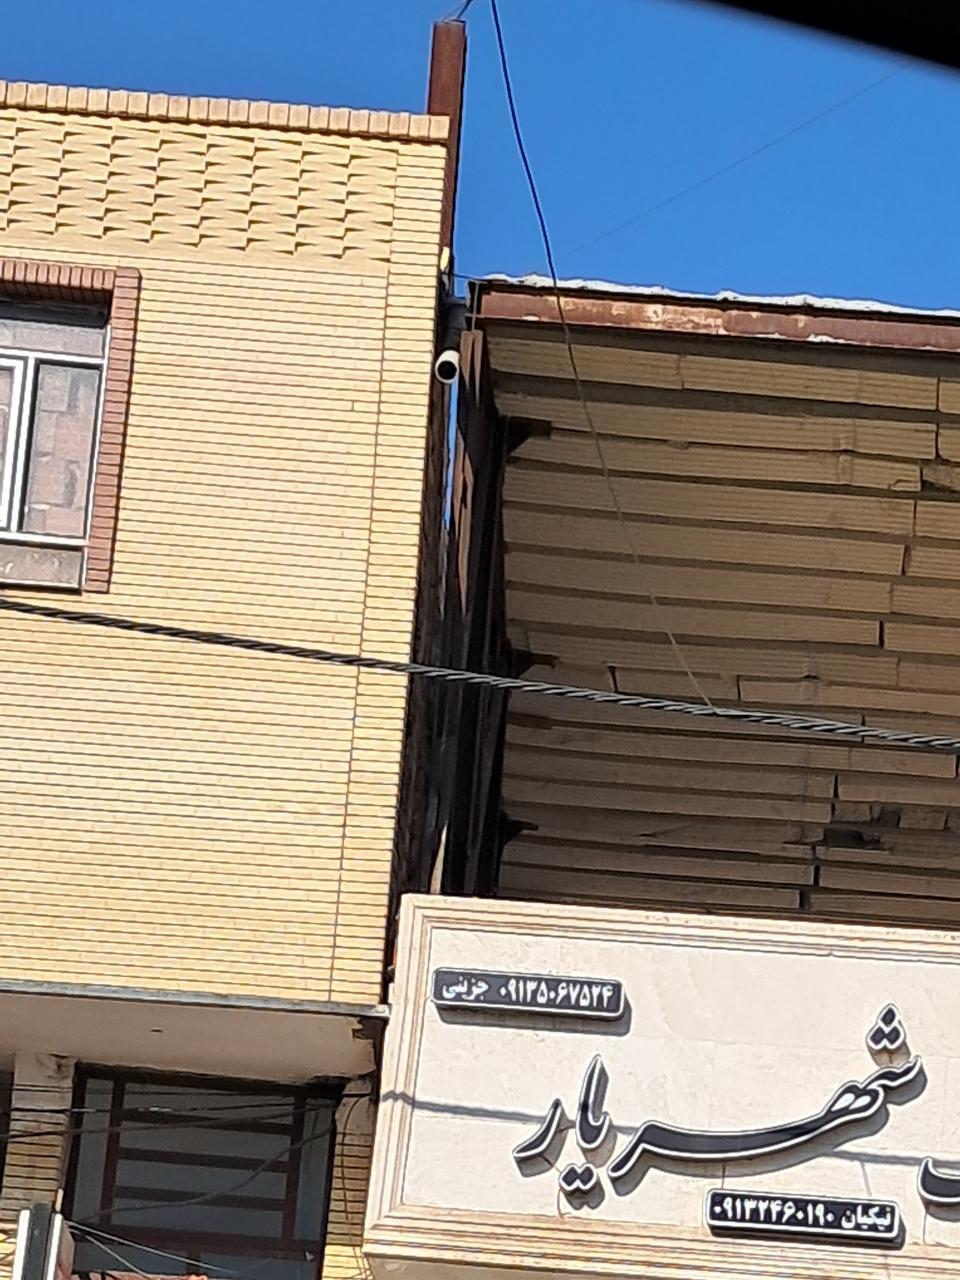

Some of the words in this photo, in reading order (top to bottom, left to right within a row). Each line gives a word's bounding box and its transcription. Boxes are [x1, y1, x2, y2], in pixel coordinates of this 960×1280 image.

[498, 978, 613, 1008] ۰۹۱۳۵۰۶۷۵۲۴
[512, 1003, 928, 1193] شهریار
[713, 1196, 835, 1226] ۰۹۱۳۲۴۶۰۱۹۰
